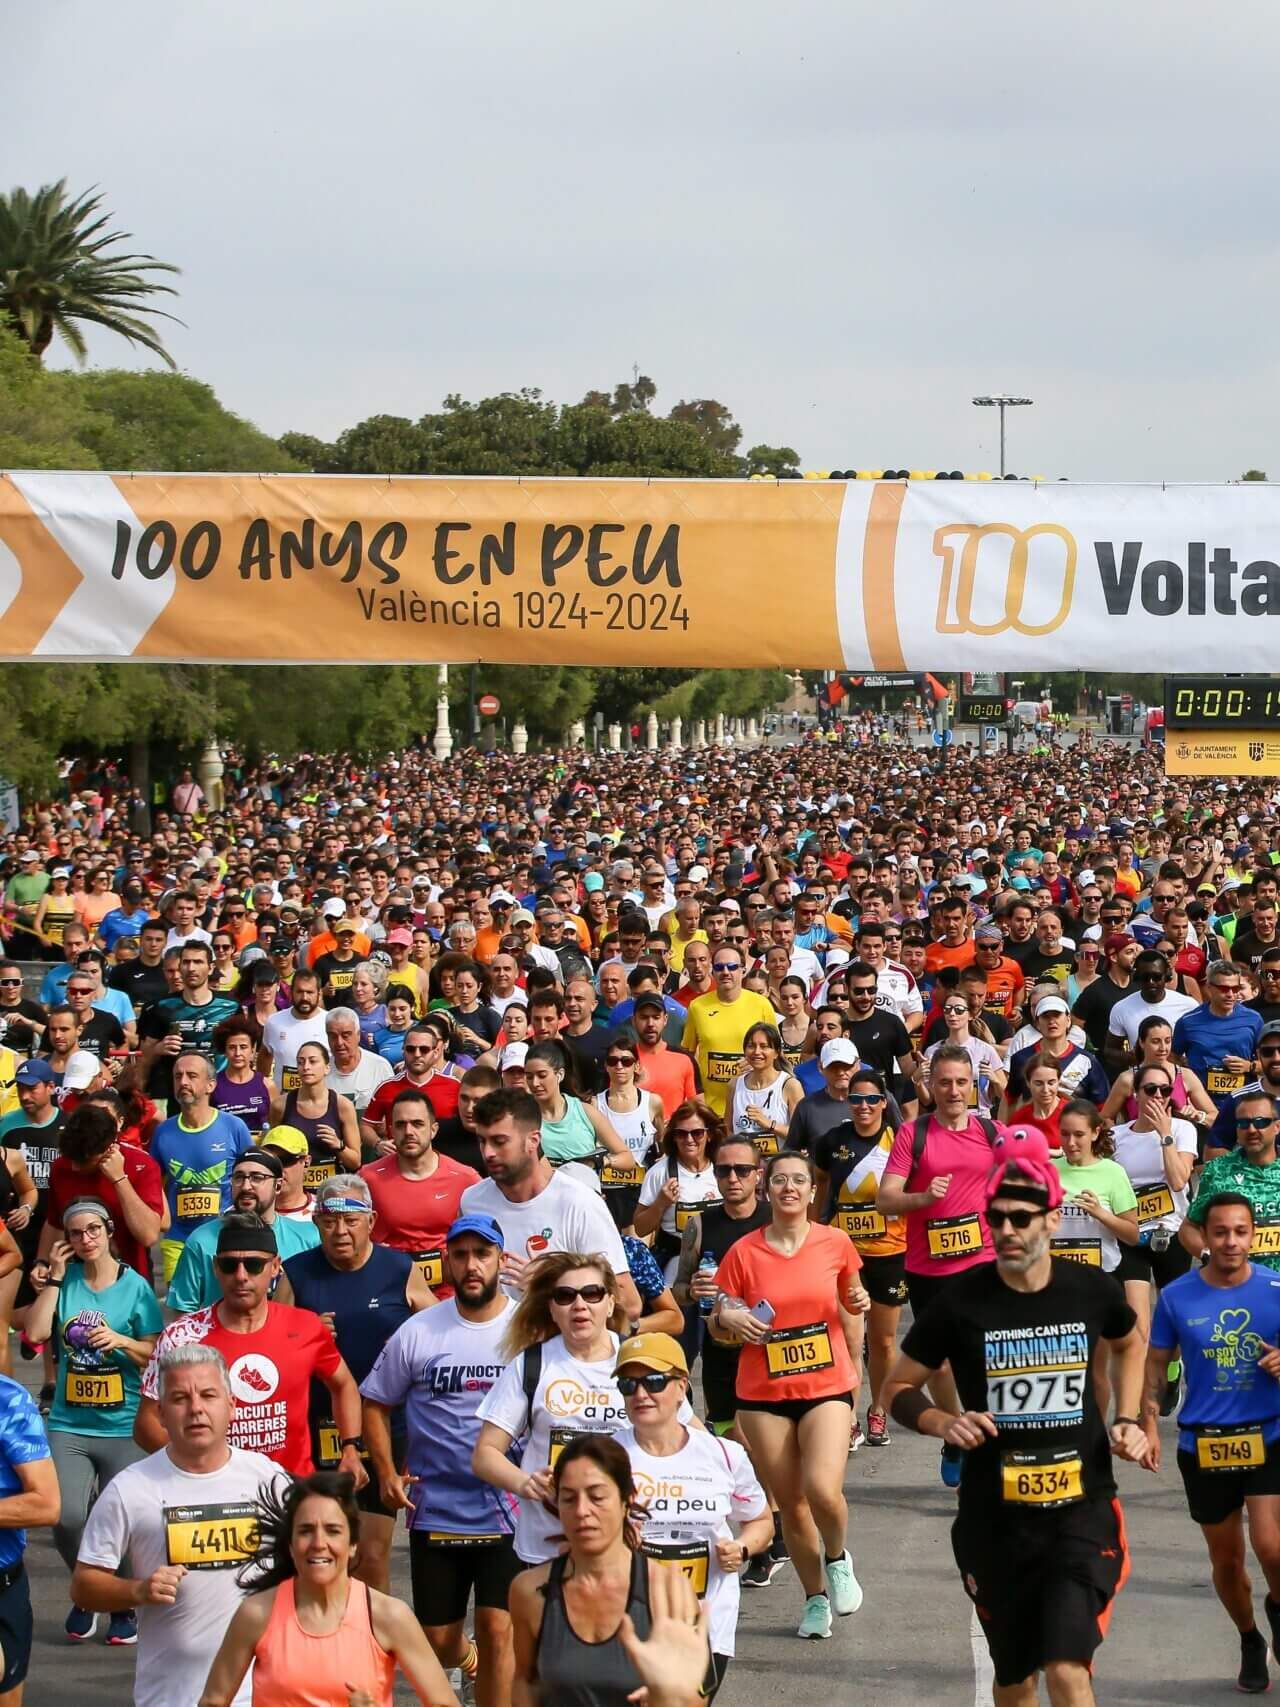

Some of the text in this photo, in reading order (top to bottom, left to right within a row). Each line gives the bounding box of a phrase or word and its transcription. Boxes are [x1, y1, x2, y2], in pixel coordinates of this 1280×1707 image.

[113, 518, 684, 588] 100 ANYS EN PEU
[933, 522, 1079, 635] 100
[357, 587, 691, 632] València 1924-2024
[969, 704, 1001, 716] 10:00
[1193, 752, 1203, 760] DE
[716, 1062, 738, 1076] 3146
[1214, 1077, 1238, 1090] 5622
[182, 1196, 211, 1211] 5339
[847, 1217, 875, 1231] 5841
[940, 1228, 970, 1247] 5716
[1250, 1231, 1280, 1248] 747
[985, 1328, 1032, 1342] NOTHING
[1033, 1325, 1059, 1338] CAN
[782, 1342, 817, 1365] 1013
[985, 1333, 1088, 1370] RUNNINMEN
[1202, 1345, 1236, 1360] YO SOY
[1216, 1356, 1236, 1369] PRO
[435, 1366, 465, 1393] 15K
[466, 1365, 506, 1378] NOCT
[75, 1380, 109, 1398] 9871
[560, 1389, 610, 1406] Volta
[990, 1373, 1082, 1412] 1975
[235, 1402, 287, 1420] RCUIT DE
[584, 1405, 627, 1422] a pe
[1210, 1440, 1252, 1460] 5749
[1017, 1472, 1069, 1495] 6334
[655, 1498, 717, 1514] a peu
[191, 1527, 240, 1554] 4411
